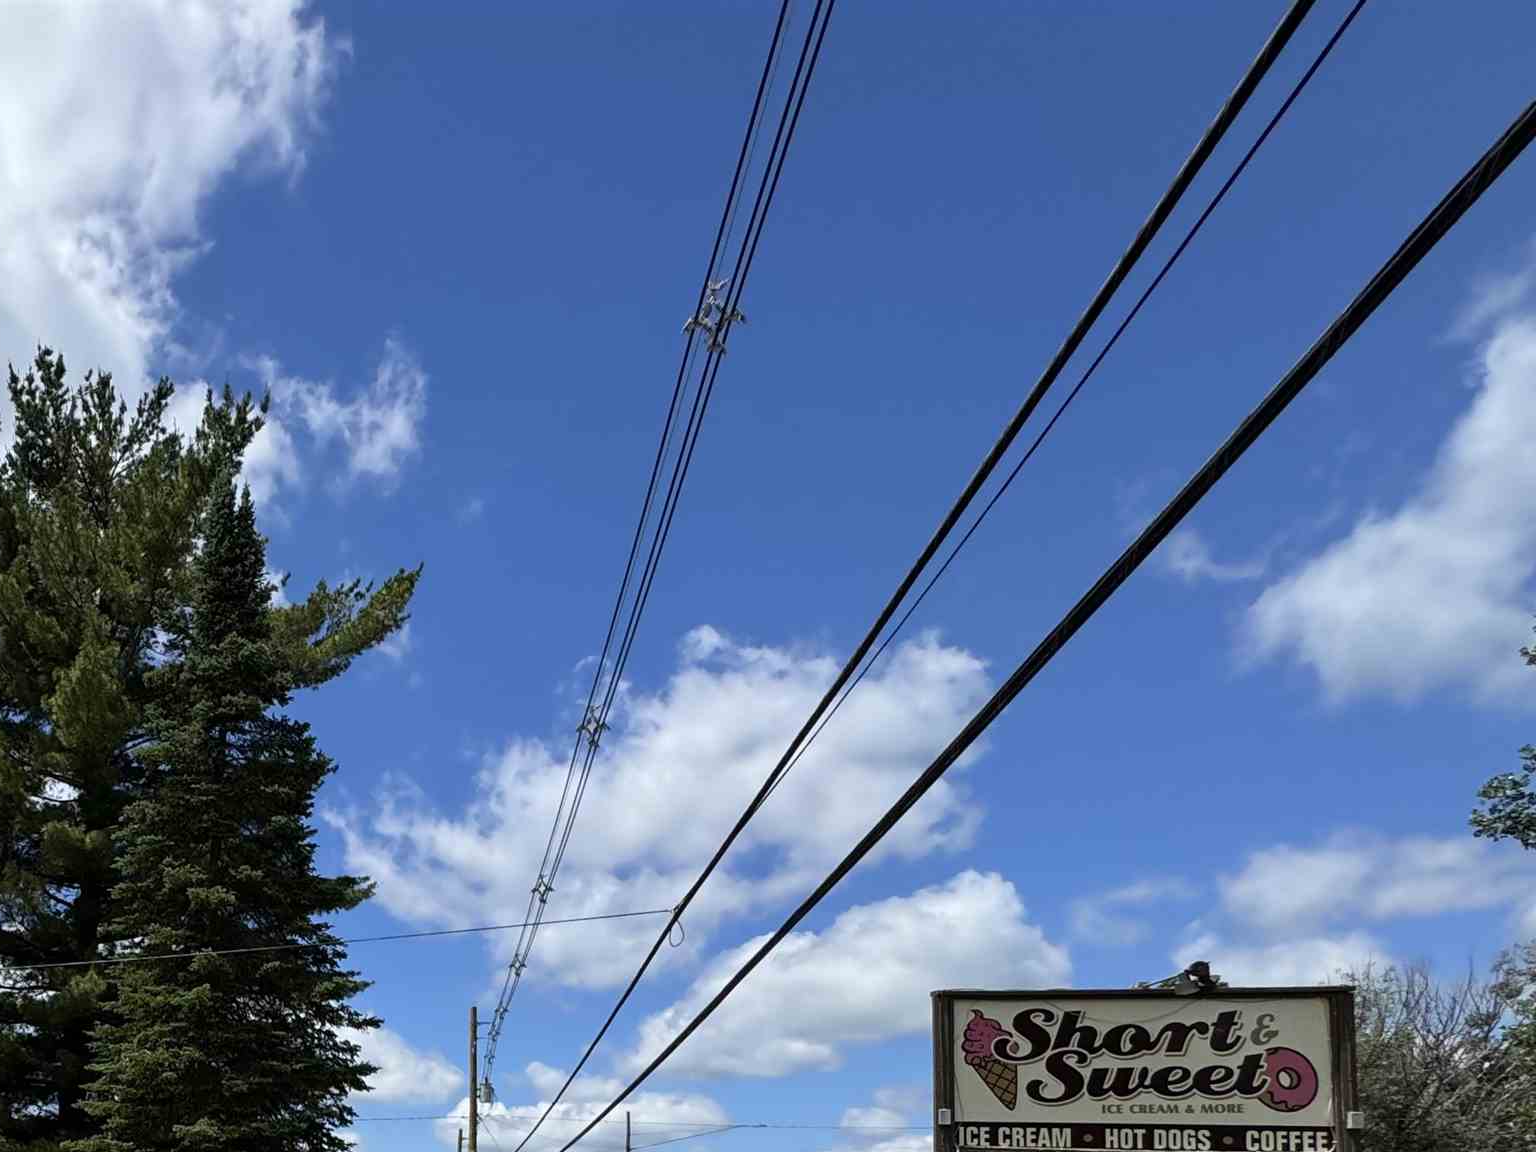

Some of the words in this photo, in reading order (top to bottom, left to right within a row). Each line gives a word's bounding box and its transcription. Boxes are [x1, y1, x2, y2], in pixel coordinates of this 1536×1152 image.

[993, 1008, 1241, 1062] Short
[1250, 1013, 1279, 1046] &
[1026, 1049, 1268, 1103] Sweet
[1101, 1103, 1124, 1114] ICE
[1129, 1103, 1179, 1114] CREAM
[1185, 1104, 1195, 1114] &
[1200, 1103, 1245, 1114] MORE
[958, 1126, 991, 1148] ICE
[997, 1126, 1072, 1149] CREAM
[1104, 1128, 1146, 1149] HOT
[1153, 1128, 1212, 1151] DOGS
[1245, 1130, 1329, 1152] COFFEE
